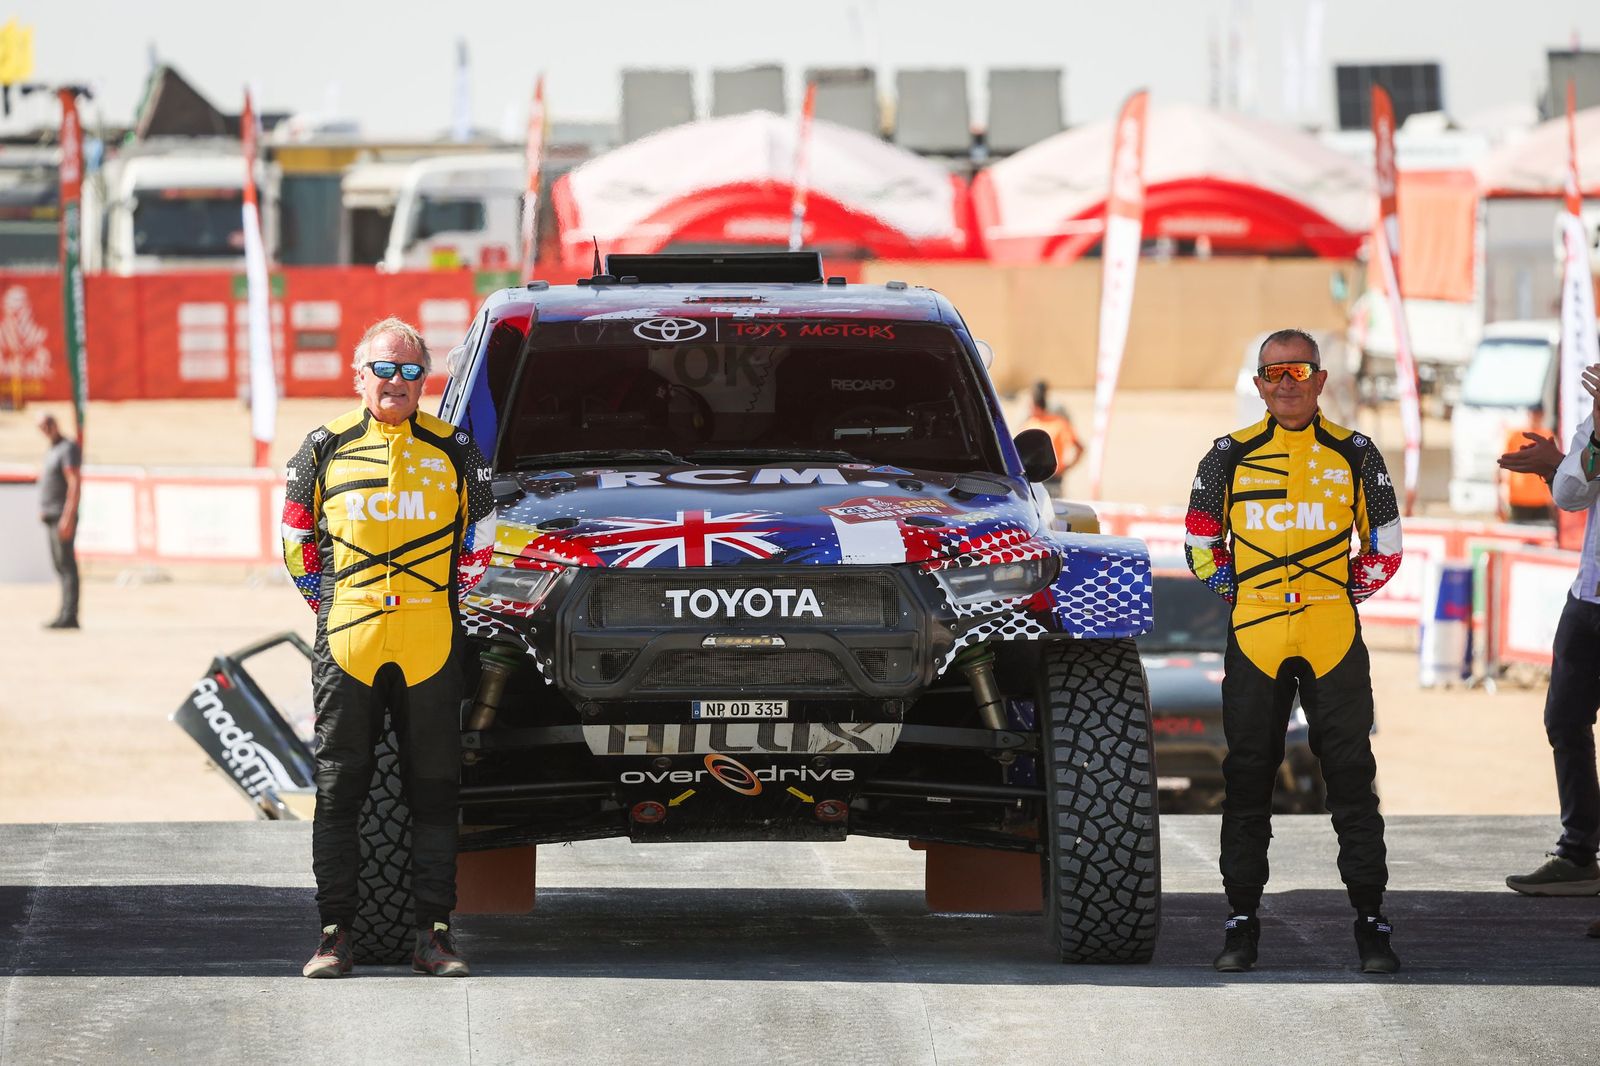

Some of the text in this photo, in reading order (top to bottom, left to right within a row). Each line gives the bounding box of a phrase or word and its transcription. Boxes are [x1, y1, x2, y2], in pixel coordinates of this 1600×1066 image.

[728, 322, 896, 340] TOYS MOTORS
[831, 378, 895, 391] RECARO
[597, 468, 890, 489] RCM.
[345, 490, 437, 522] RCM.
[1245, 500, 1338, 532] RCM.
[665, 587, 824, 618] TOYOTA
[730, 702, 750, 717] OD
[754, 702, 784, 717] 335
